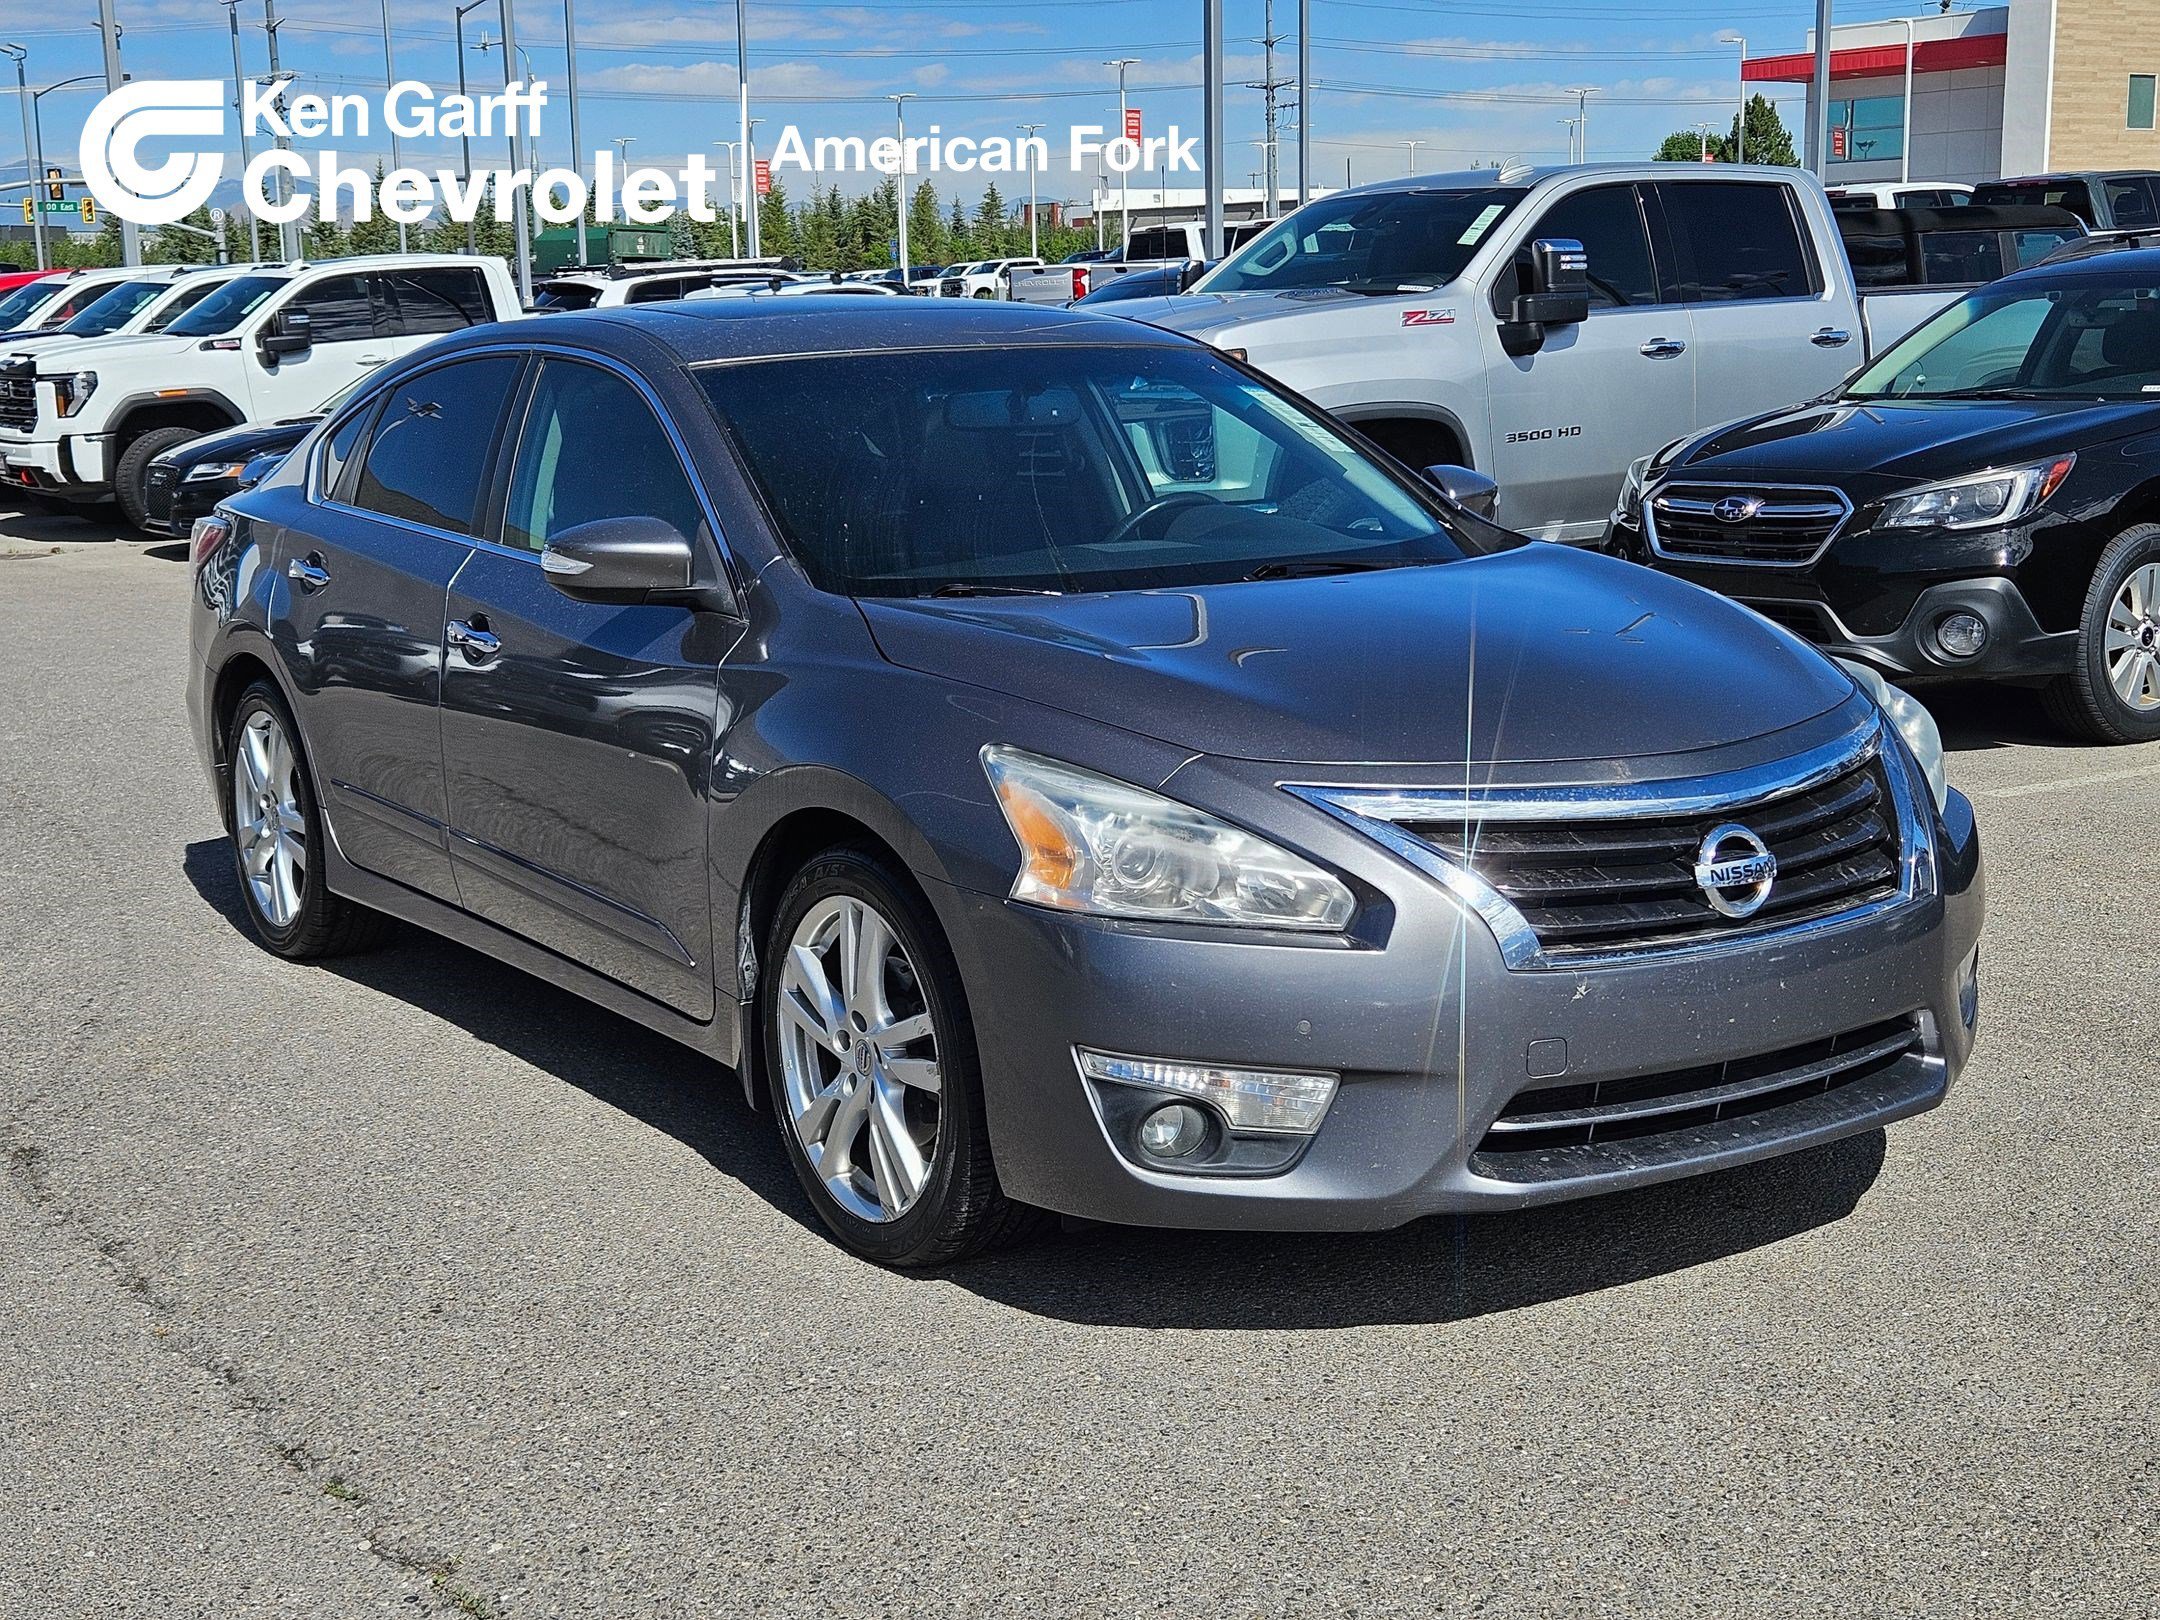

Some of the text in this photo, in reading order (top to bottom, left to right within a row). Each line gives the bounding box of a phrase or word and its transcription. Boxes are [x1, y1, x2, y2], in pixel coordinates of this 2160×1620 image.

[60, 203, 74, 211] East
[1401, 308, 1456, 327] Z71
[1505, 426, 1582, 444] 3500 HD
[1710, 860, 1774, 882] NISSAN
